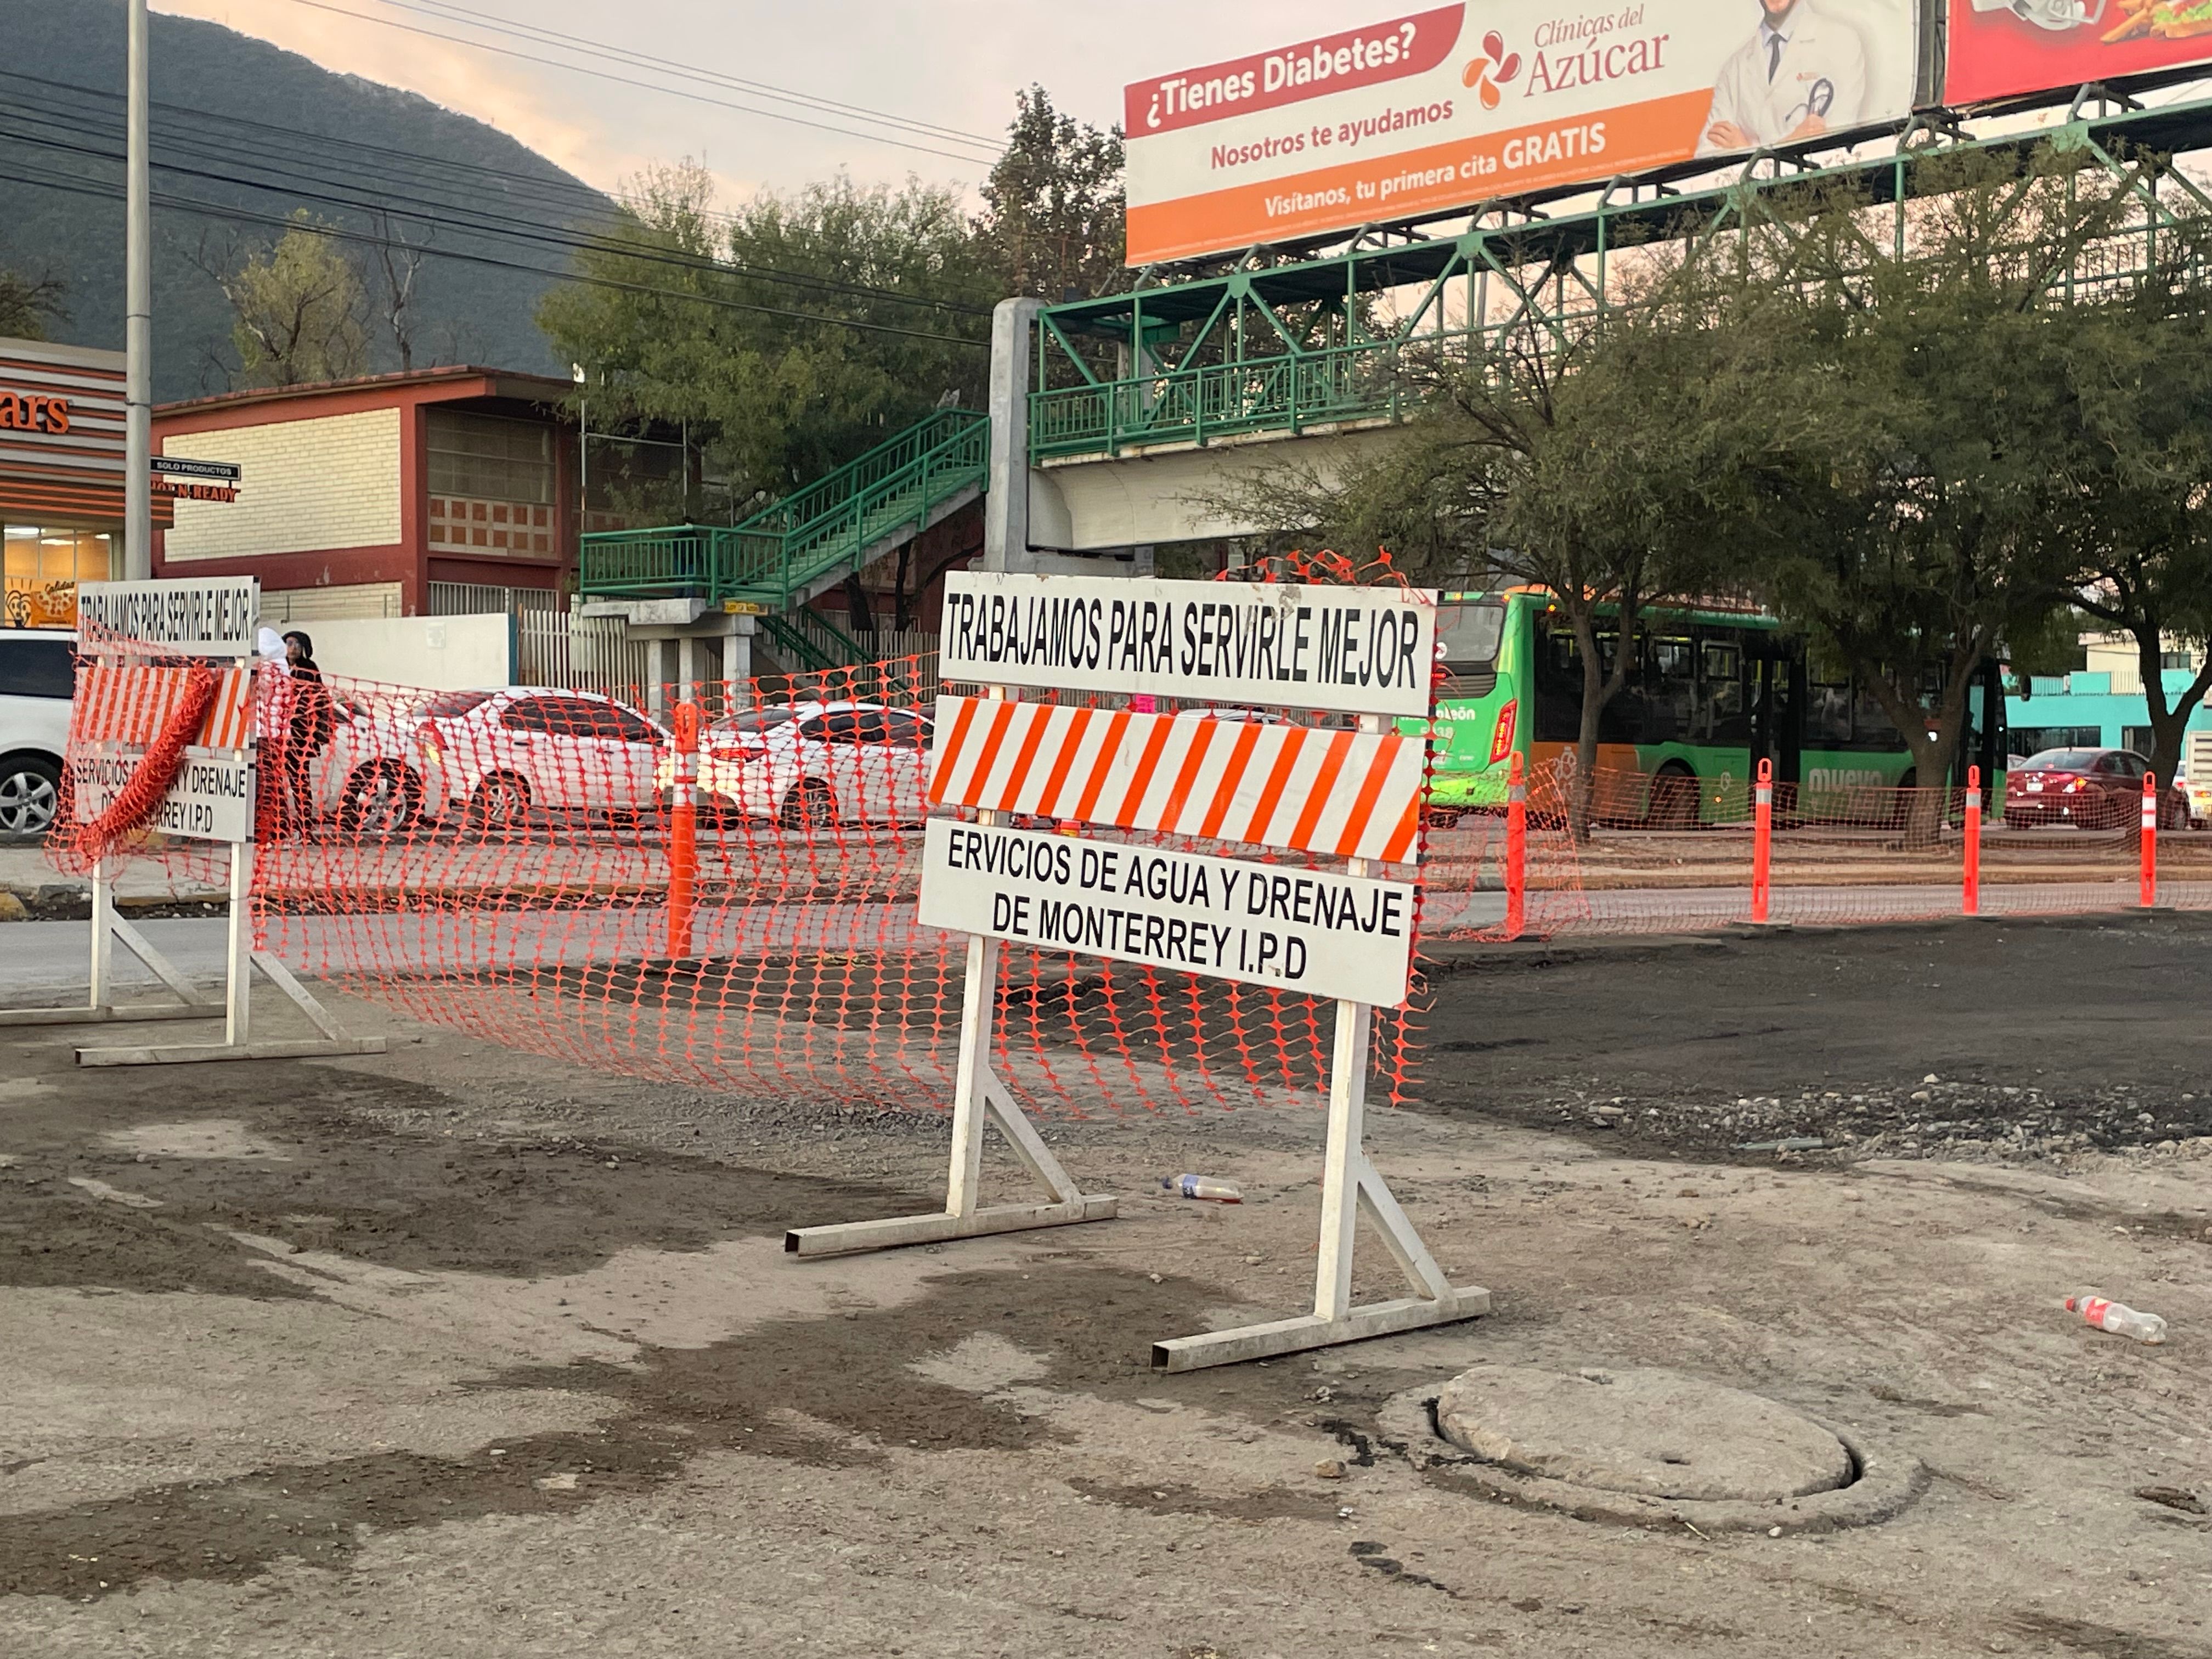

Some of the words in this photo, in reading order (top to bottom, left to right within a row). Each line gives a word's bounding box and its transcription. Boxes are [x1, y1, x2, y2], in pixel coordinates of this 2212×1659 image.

[1534, 13, 1615, 48] Clínicas
[1618, 4, 1645, 28] del
[1147, 71, 1255, 128] ¿Tienes
[1264, 22, 1417, 93] Diabetes?
[1523, 34, 1669, 98] Azúcar
[1211, 132, 1305, 170] Nosotros
[1312, 126, 1332, 147] te
[1338, 100, 1454, 146] ayudamos
[1265, 185, 1351, 217] Visítanos,
[1356, 180, 1375, 200] tu
[1380, 165, 1455, 201] primera
[1460, 154, 1497, 178] cita
[1503, 122, 1606, 170] GRATIS
[157, 462, 180, 471] SOLO
[182, 464, 232, 476] PRODUCTOS
[81, 592, 139, 641] TRABAJAMOS
[142, 592, 165, 641] PARA
[167, 590, 212, 642] SERVIRLE
[215, 589, 249, 641] MEJOR
[948, 593, 1102, 669] TRABAJAMOS
[1108, 600, 1173, 674] PARA
[1181, 602, 1311, 682] SERVIRLE
[1318, 608, 1419, 689] MEJOR
[76, 758, 129, 786] SERVICIOS
[182, 765, 190, 791] Y
[192, 766, 246, 798] DRENAJE
[190, 803, 212, 833] I.P.D
[949, 829, 1071, 885] ERVICIOS
[1080, 848, 1118, 893] DE
[1124, 855, 1210, 907] AGUA
[1220, 868, 1240, 911] Y
[1248, 872, 1402, 936] DRENAJE
[993, 893, 1030, 936] DE
[1039, 899, 1232, 967] MONTERREY
[1239, 928, 1306, 979] I.P.D
